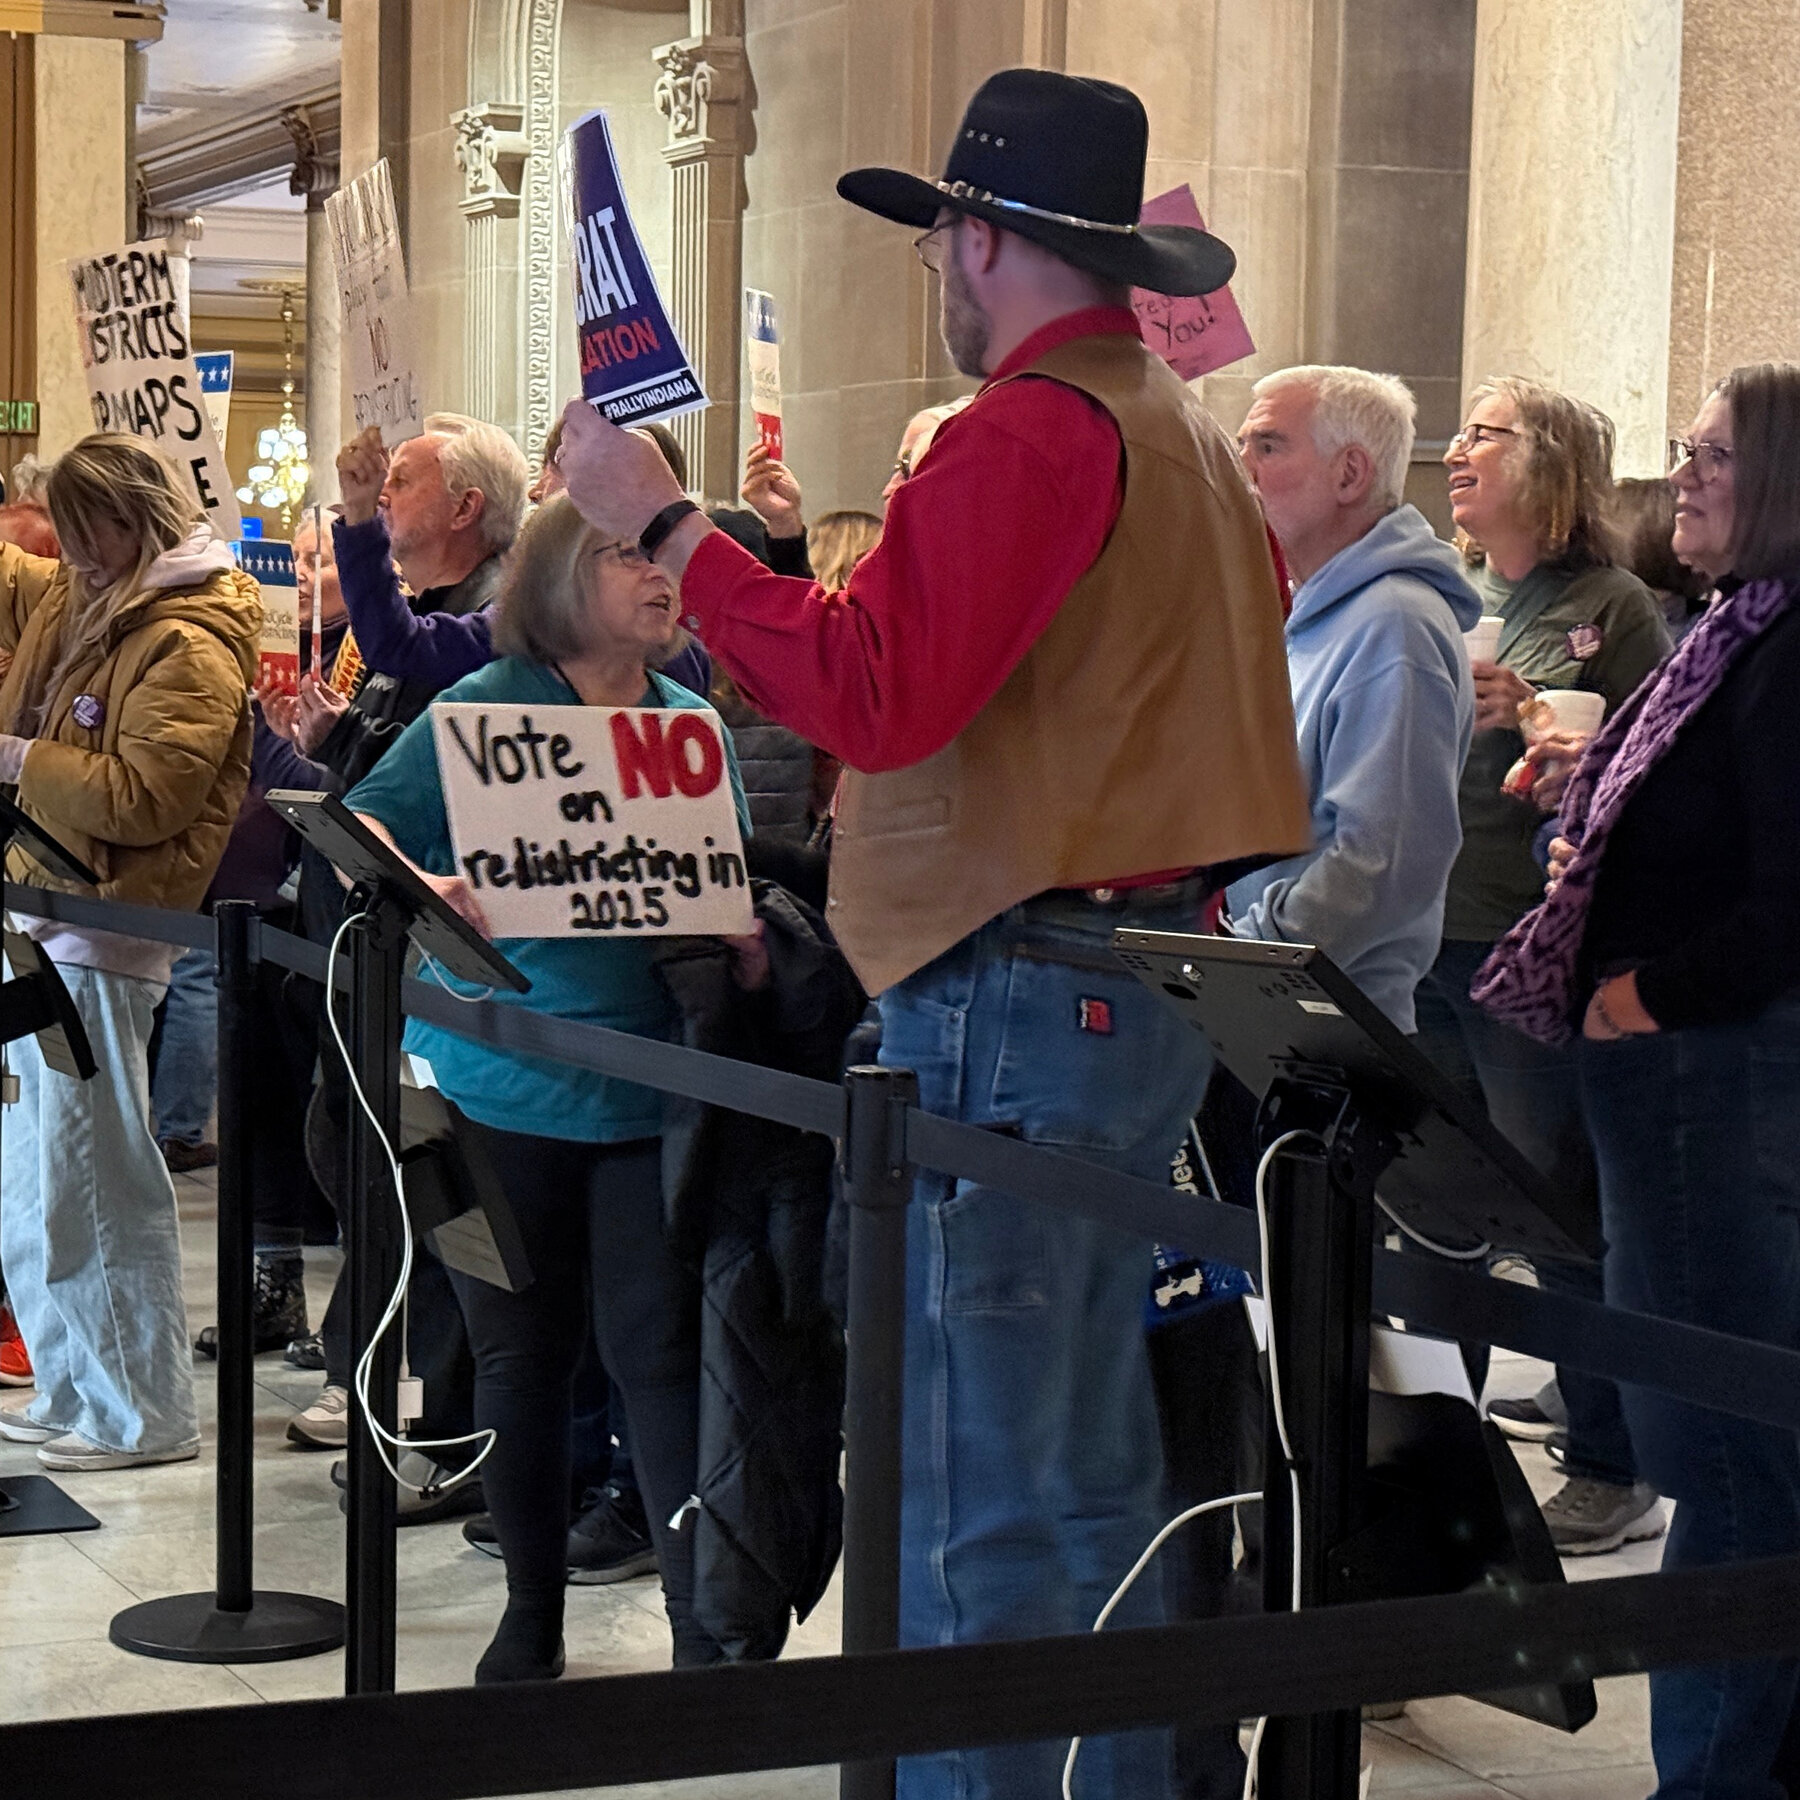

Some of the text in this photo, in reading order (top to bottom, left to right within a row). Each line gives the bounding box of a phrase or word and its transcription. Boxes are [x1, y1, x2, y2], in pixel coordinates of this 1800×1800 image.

[575, 206, 638, 326] RAT
[582, 316, 661, 375] ATION
[604, 378, 697, 418] #RALLYINDIANA
[445, 710, 724, 800] Vote NO
[560, 790, 614, 822] on
[704, 835, 745, 888] in
